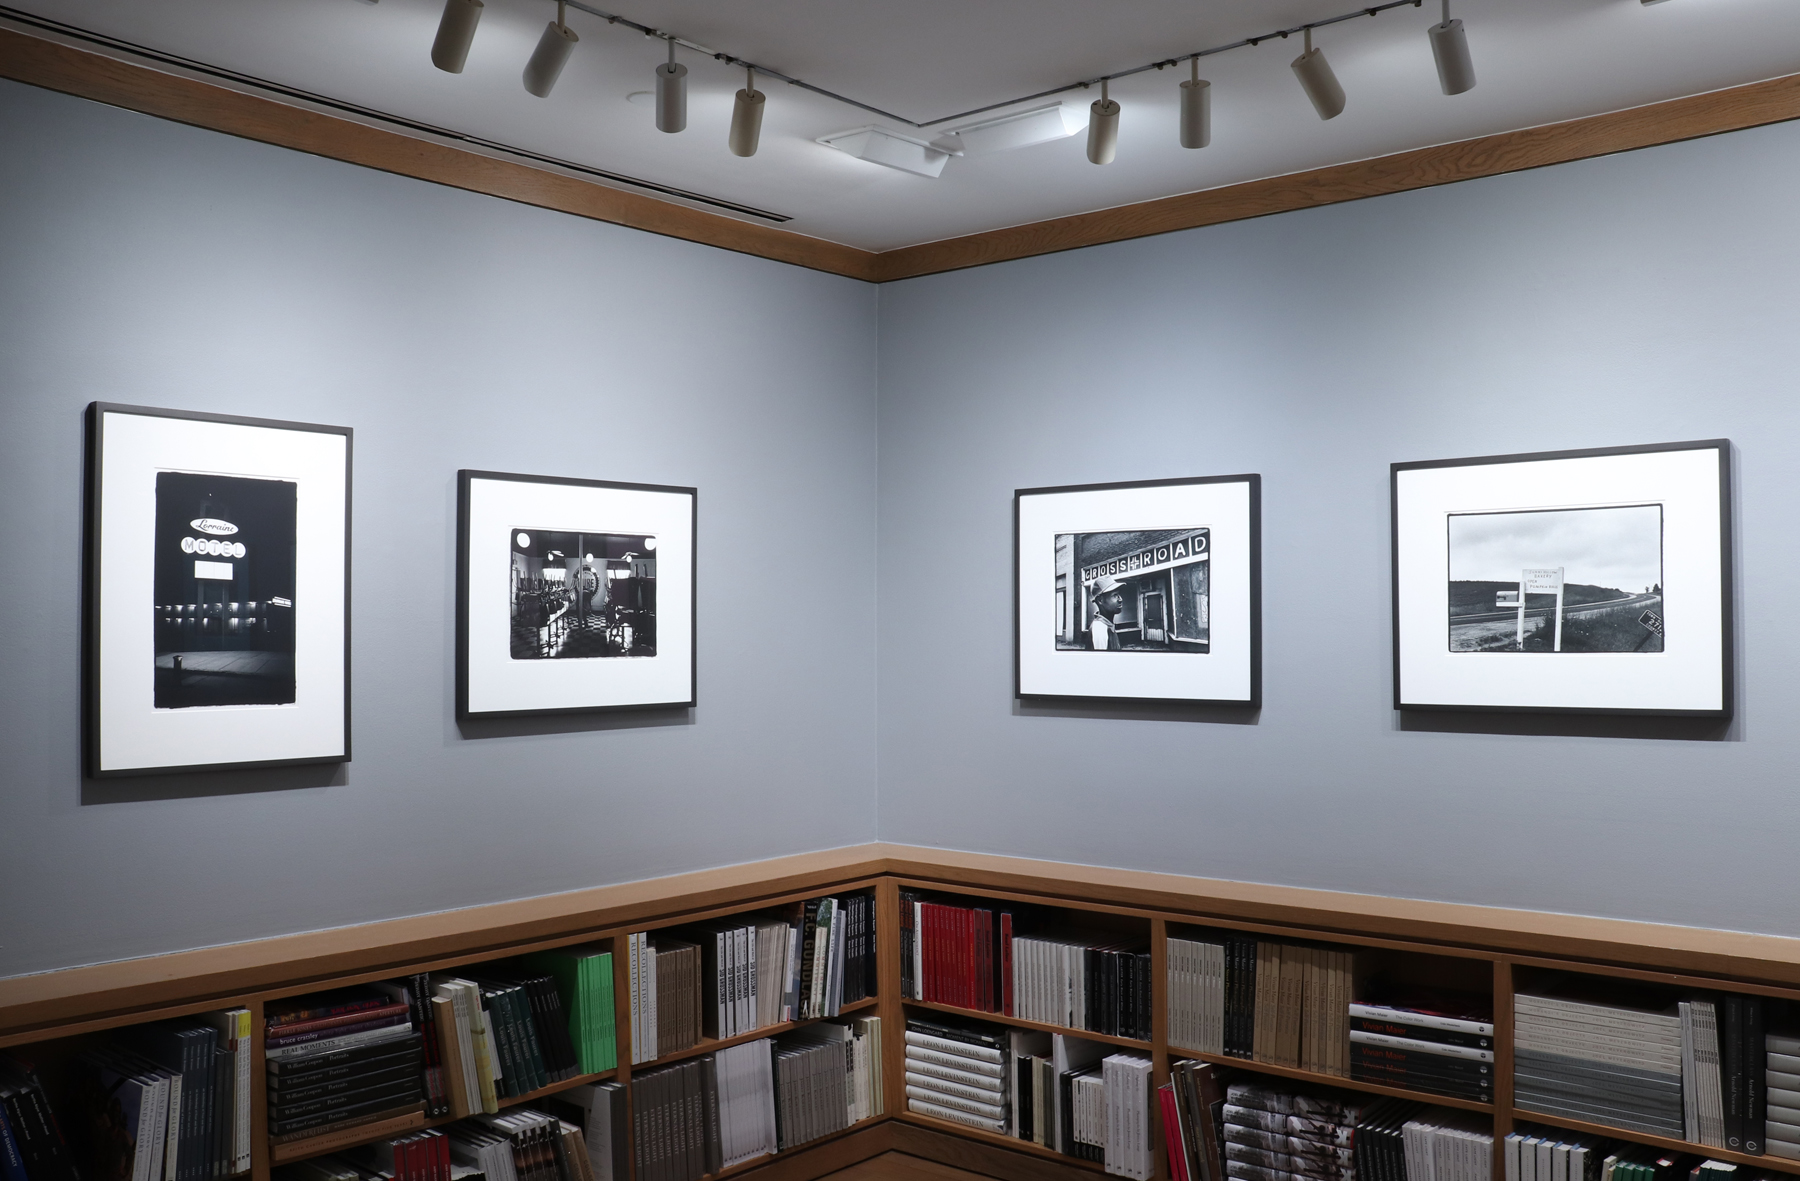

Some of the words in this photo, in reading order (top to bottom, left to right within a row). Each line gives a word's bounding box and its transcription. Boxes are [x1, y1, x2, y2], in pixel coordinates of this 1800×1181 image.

[196, 519, 235, 532] Lorraine
[184, 539, 243, 556] MOTEL
[1143, 536, 1206, 566] ROAD
[805, 913, 816, 935] F.C.
[1363, 1021, 1384, 1030] Vivian
[1386, 1025, 1406, 1034] Maier
[280, 1036, 296, 1045] bruce
[297, 1033, 318, 1042] cratsley
[282, 1046, 299, 1055] REAL
[300, 1040, 335, 1052] MOMENTS
[923, 1040, 940, 1048] LEON
[941, 1044, 980, 1057] LEVINSTEIN
[1363, 1047, 1383, 1057] Vivian
[1386, 1051, 1406, 1060] Maier
[924, 1054, 940, 1062] LEON
[942, 1057, 980, 1071] LEVINSTEIN
[923, 1067, 939, 1075] LEON
[941, 1071, 980, 1085] LEVINSTEIN
[159, 1083, 167, 1110] BOUND
[173, 1079, 181, 1106] BOUND
[923, 1081, 940, 1089] LEON
[942, 1084, 980, 1098] LEVINSTEIN
[143, 1090, 151, 1117] BOUND
[924, 1094, 940, 1102] LEON
[942, 1098, 980, 1112] LEVINSTEIN
[927, 1108, 943, 1117] LEON
[945, 1112, 983, 1127] LEVINSTEIN
[138, 1128, 146, 1154] GLORY
[155, 1120, 163, 1146] GLORY
